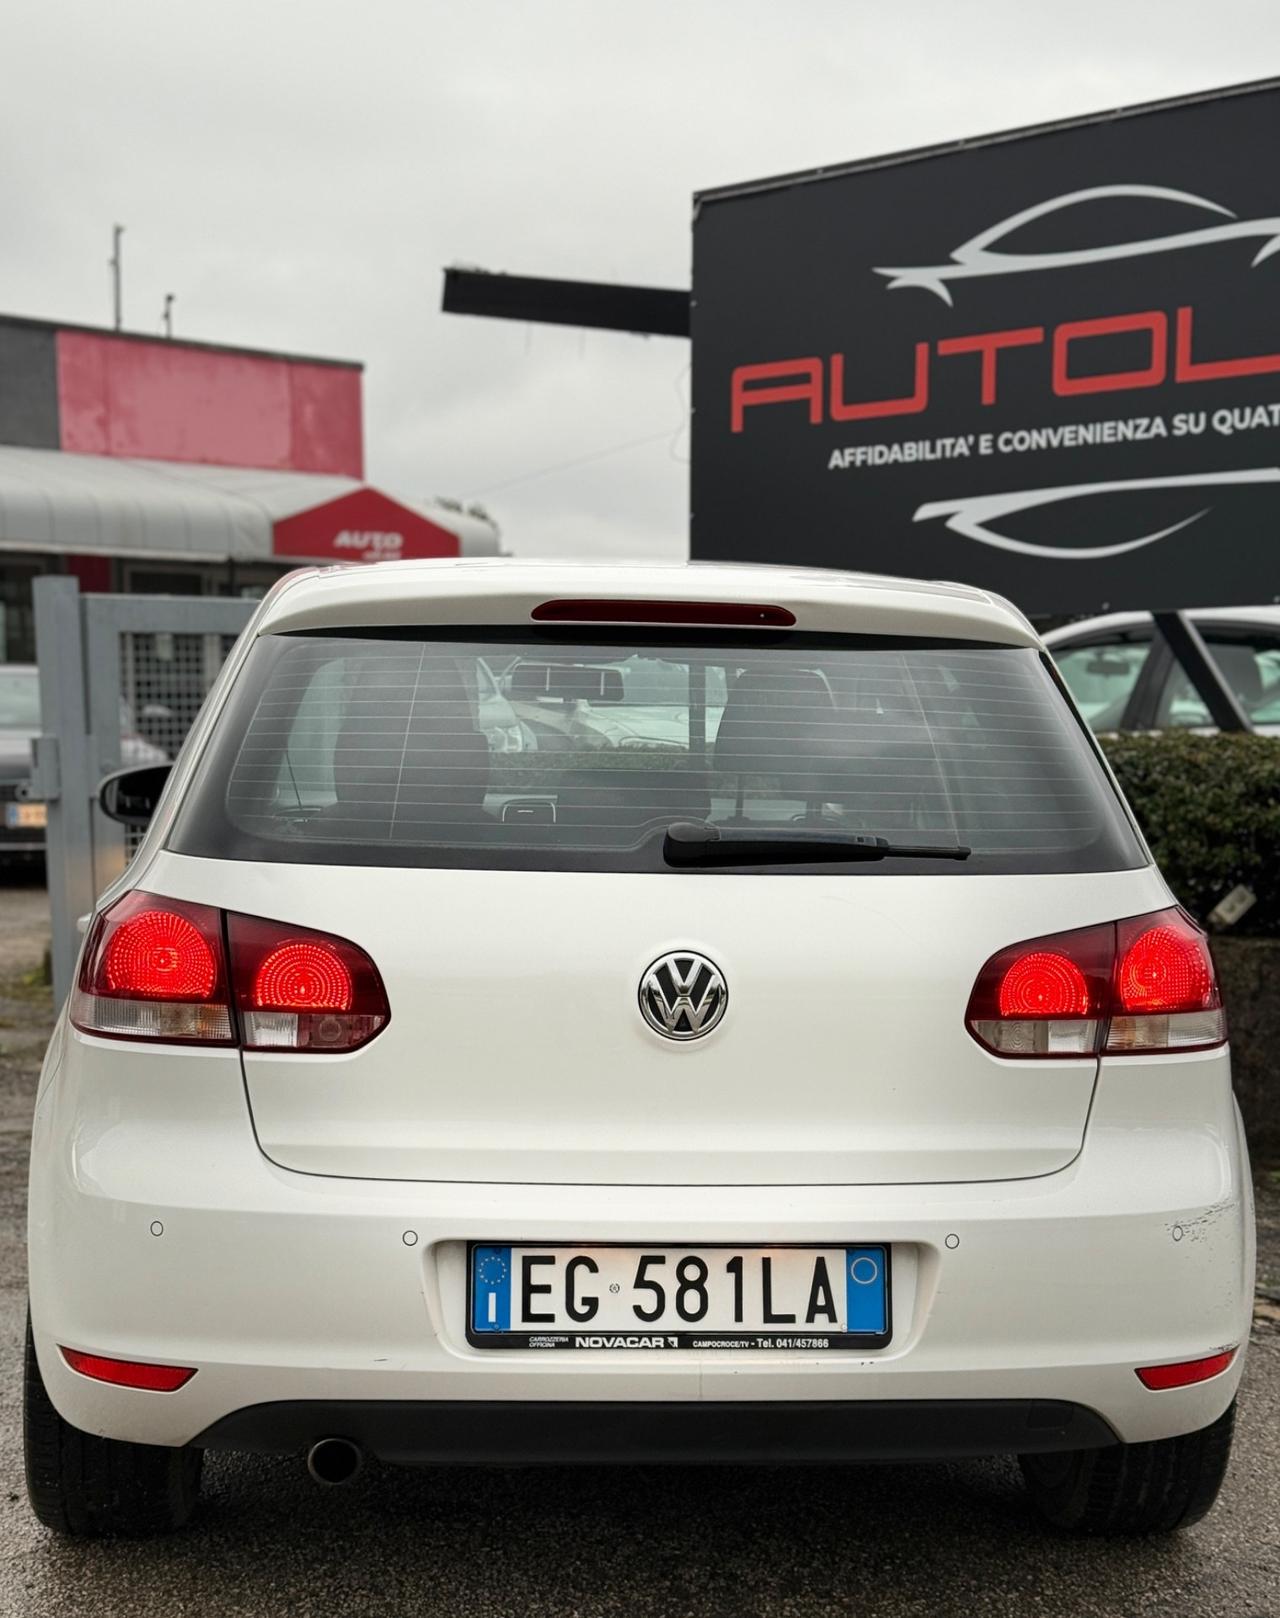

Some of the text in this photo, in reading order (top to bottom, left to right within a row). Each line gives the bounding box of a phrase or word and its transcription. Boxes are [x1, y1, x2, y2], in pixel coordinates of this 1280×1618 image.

[731, 307, 1280, 432] AUTOL
[979, 434, 993, 454] E
[997, 416, 1168, 453] CONVENIENZA
[1172, 411, 1207, 436] SU
[1211, 404, 1280, 435] QUAT
[333, 531, 404, 549] AUTO
[521, 1255, 600, 1324] EG
[575, 1336, 665, 1348] NOVACAR
[756, 1338, 775, 1348] Tel.
[776, 1338, 829, 1348] 041/457866
